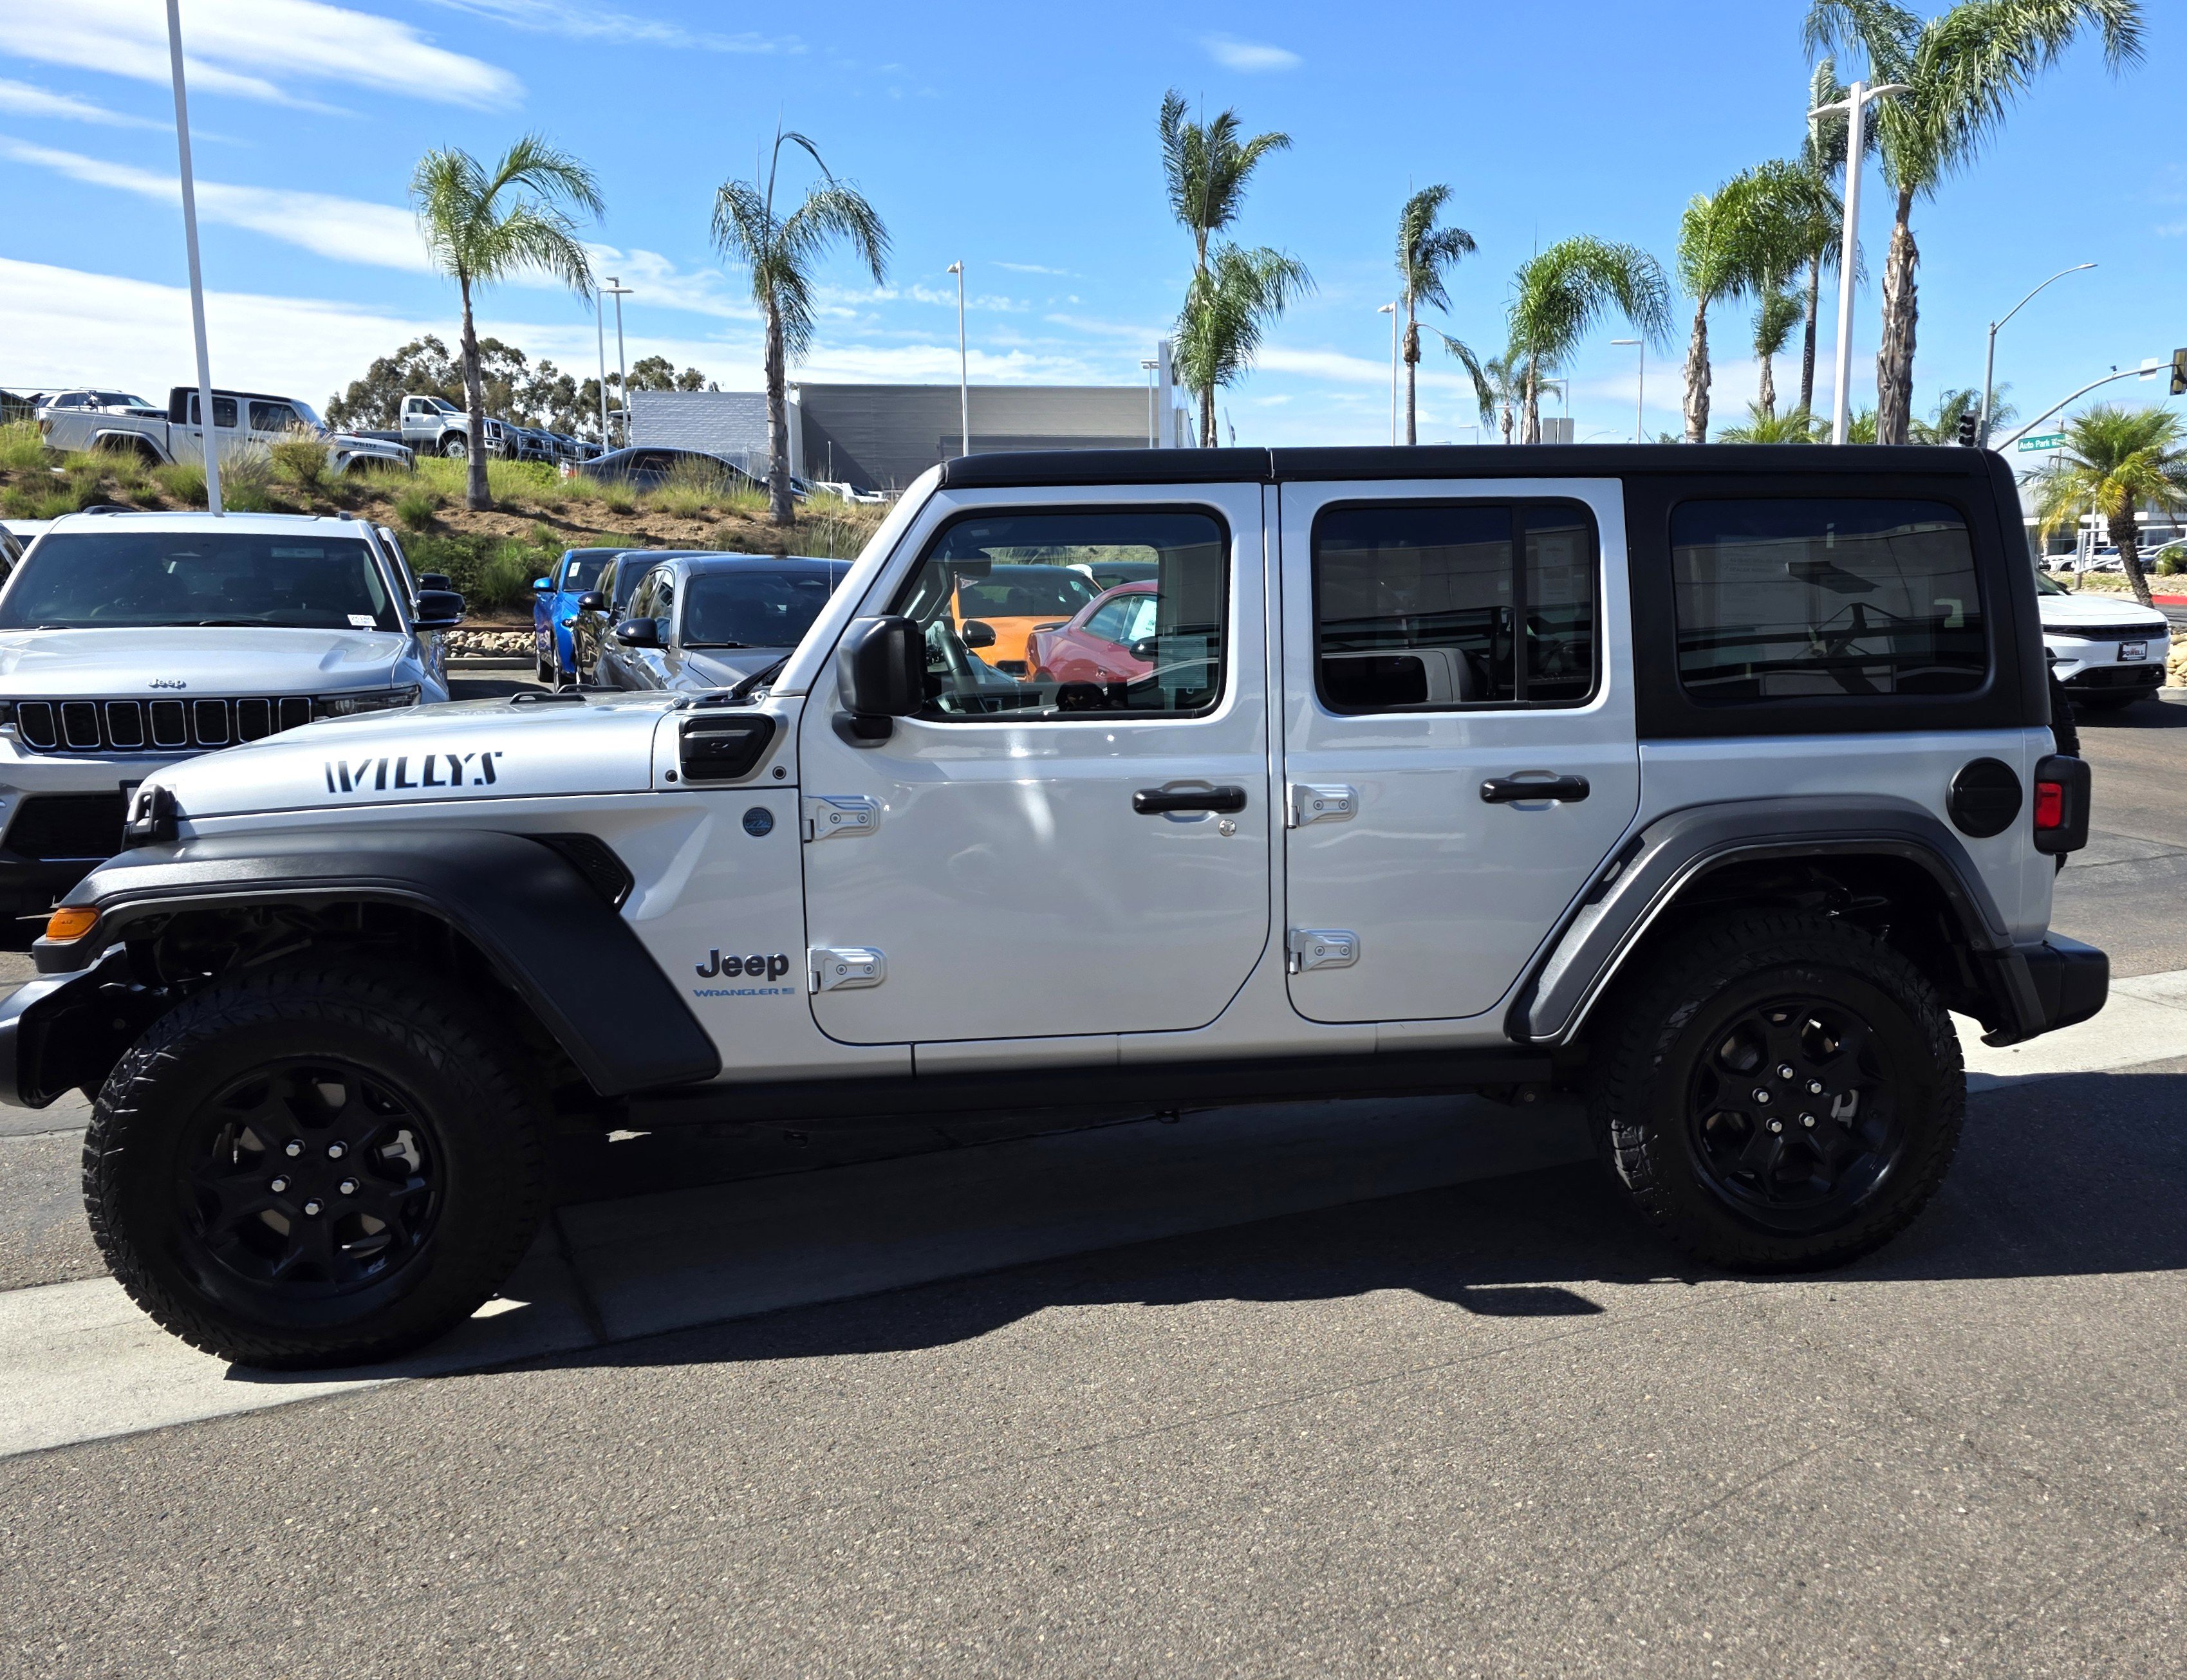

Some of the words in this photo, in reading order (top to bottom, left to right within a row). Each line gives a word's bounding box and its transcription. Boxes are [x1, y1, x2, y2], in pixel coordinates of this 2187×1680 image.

[2019, 441, 2034, 450] Auto
[2035, 439, 2050, 448] Park
[147, 677, 185, 688] Jeep
[324, 751, 503, 794] WILLYS
[695, 947, 790, 982] Jeep
[693, 988, 779, 997] WRANGLER
